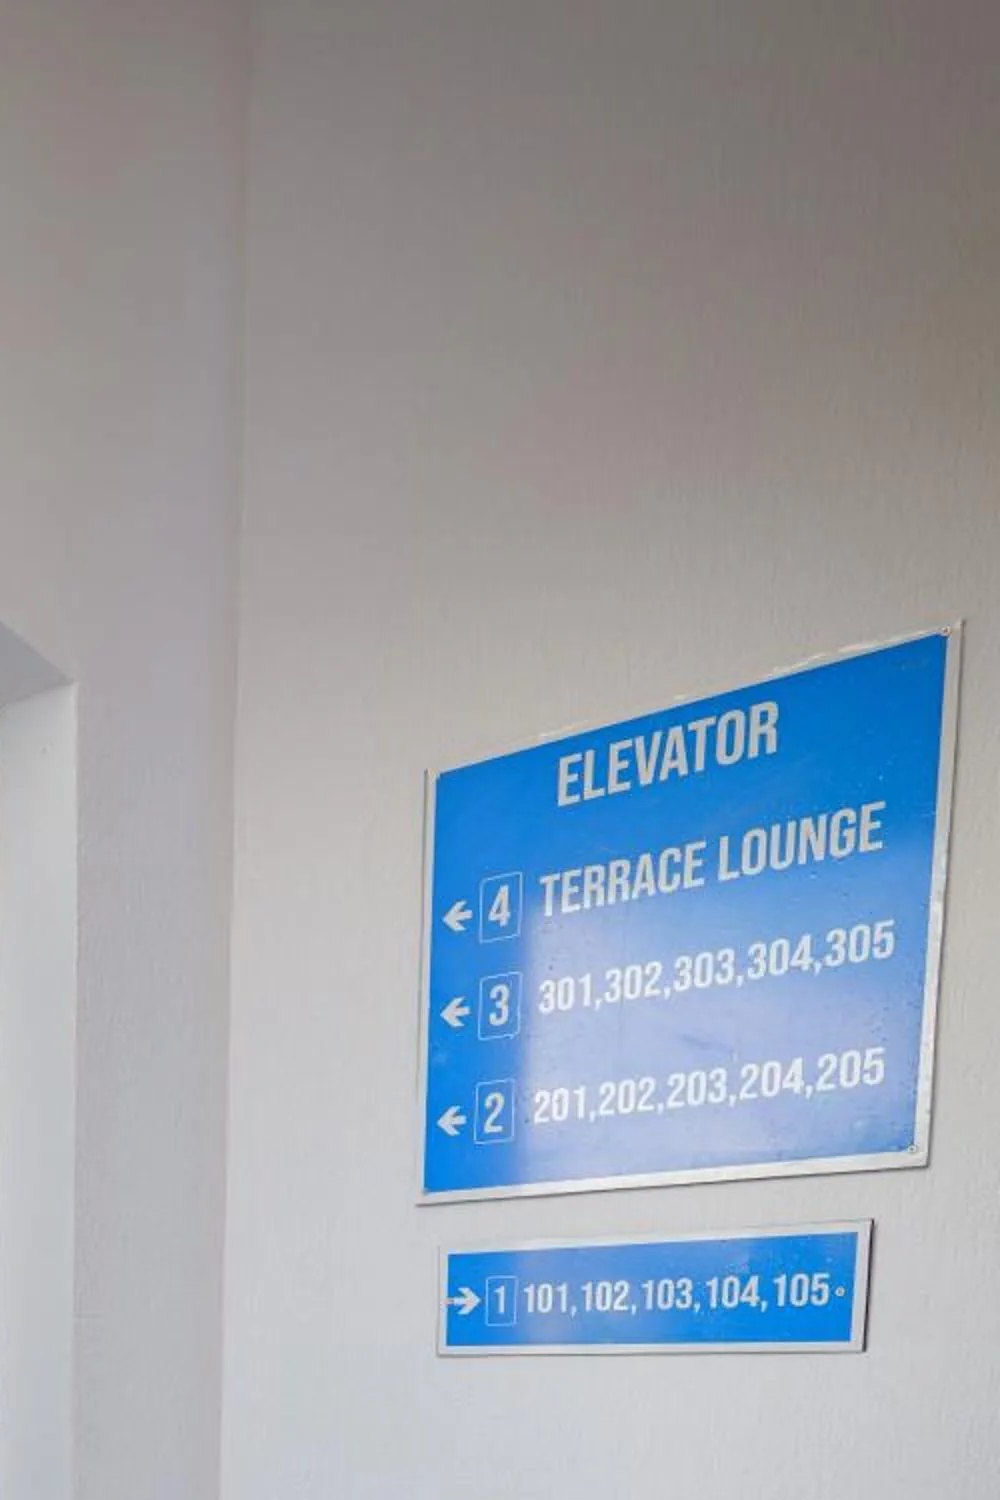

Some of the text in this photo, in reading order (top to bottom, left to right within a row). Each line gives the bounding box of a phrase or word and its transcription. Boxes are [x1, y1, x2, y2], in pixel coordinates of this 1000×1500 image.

[556, 700, 780, 808] ELEVATOR
[487, 800, 887, 928] 4 TERRACE LOUNGE
[488, 983, 511, 1027] 3
[483, 1090, 505, 1135] 2
[494, 1285, 506, 1314] 1
